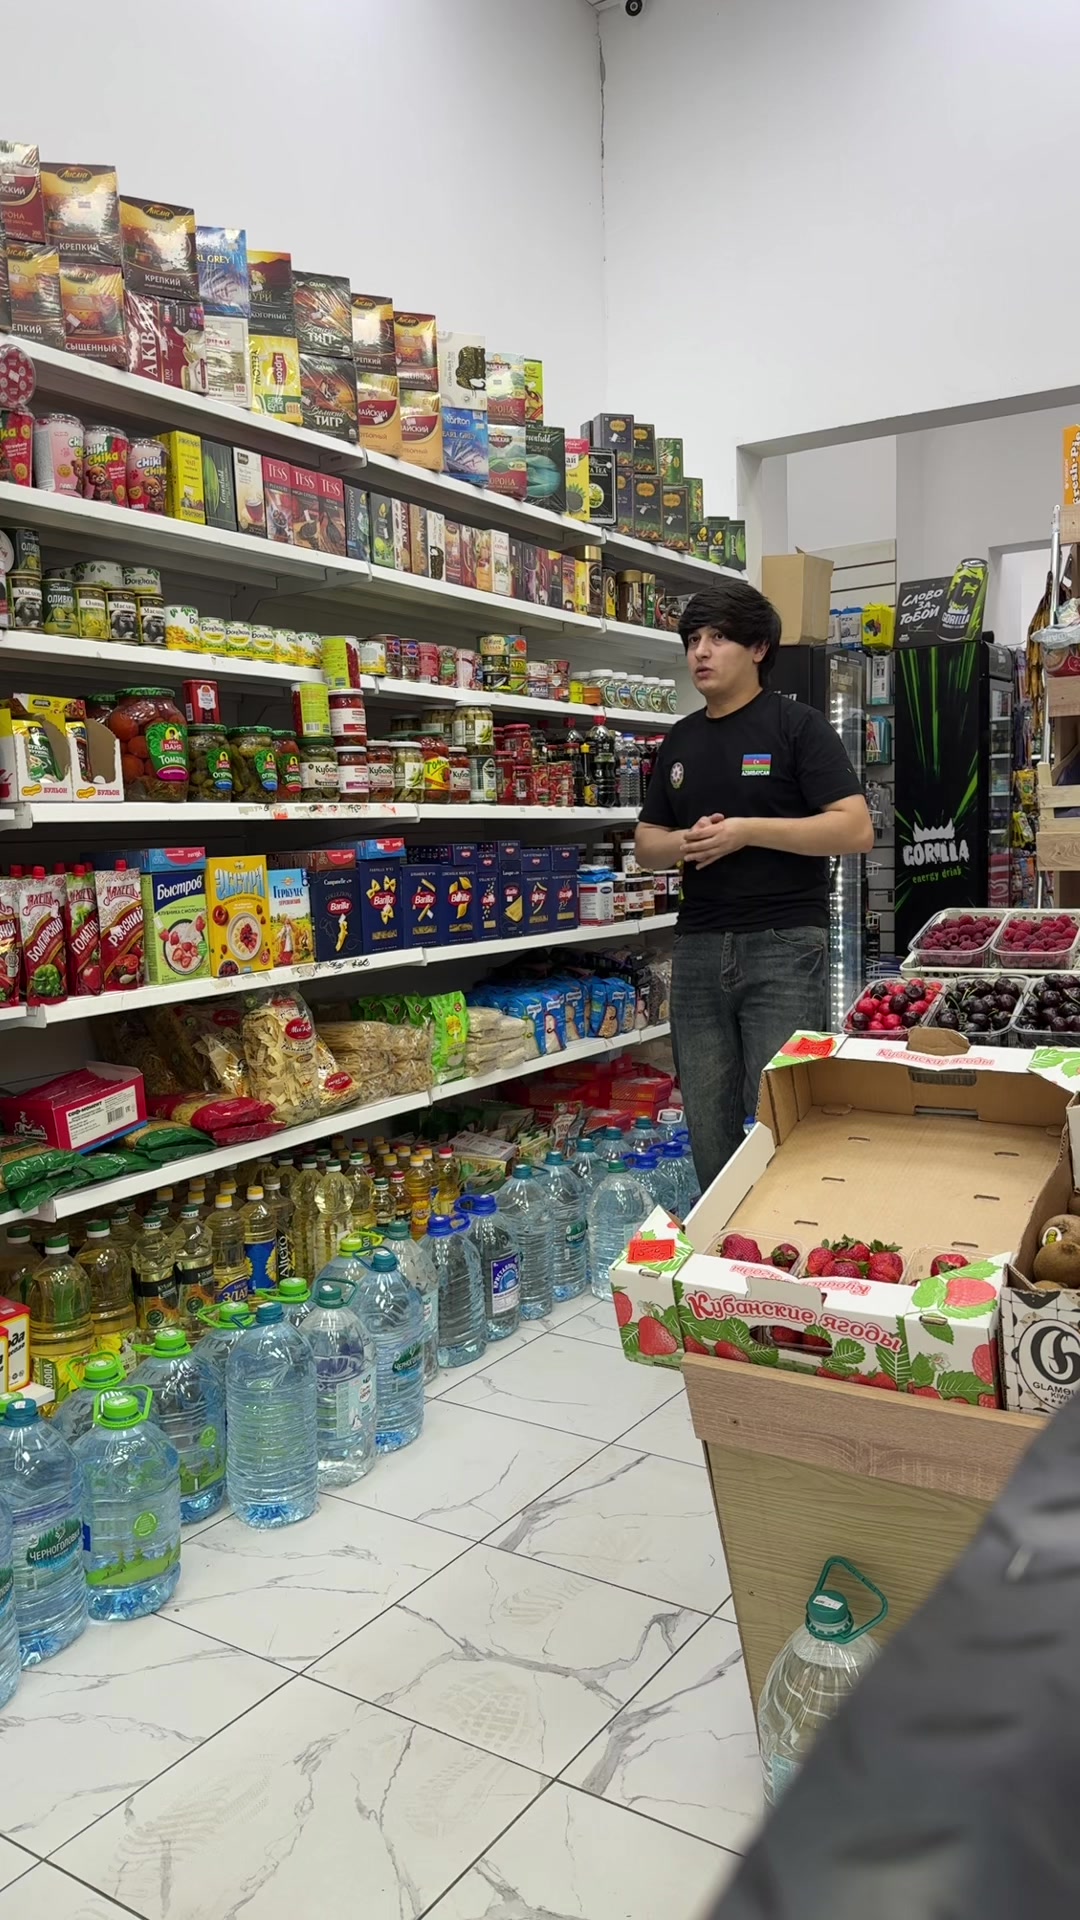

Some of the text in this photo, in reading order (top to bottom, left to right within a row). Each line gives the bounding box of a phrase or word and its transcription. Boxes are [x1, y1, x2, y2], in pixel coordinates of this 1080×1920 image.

[60, 243, 99, 252] КРЕПКИЙ
[208, 254, 230, 264] GREY
[145, 274, 180, 286] КРЕПКИЙ
[12, 323, 42, 334] ЕПКИЙ
[65, 342, 118, 353] СЫЩЕННЫЙ
[276, 354, 284, 386] Lipton
[315, 414, 344, 428] ТИГР
[268, 463, 288, 482] TESS
[294, 471, 315, 489] TESS
[321, 479, 341, 497] TESS
[901, 588, 944, 608] СЛОВО
[918, 600, 931, 611] ЗА
[900, 605, 940, 626] ТОБОЙ
[941, 611, 970, 625] GORILLA
[158, 755, 187, 767] Томаты
[903, 839, 970, 867] GORILLA
[215, 865, 265, 900] ЭКСТРА
[912, 865, 963, 884] energy drink
[157, 877, 203, 901] Быстров
[330, 902, 350, 912] Barilla
[374, 896, 394, 906] Barilla
[415, 895, 435, 904] Barilla
[108, 906, 144, 948] РУССКИЙ
[27, 914, 64, 962] БОЛГАРСКИЙ
[279, 1236, 289, 1277] Altero
[687, 1291, 902, 1352] Кубанские ягоды
